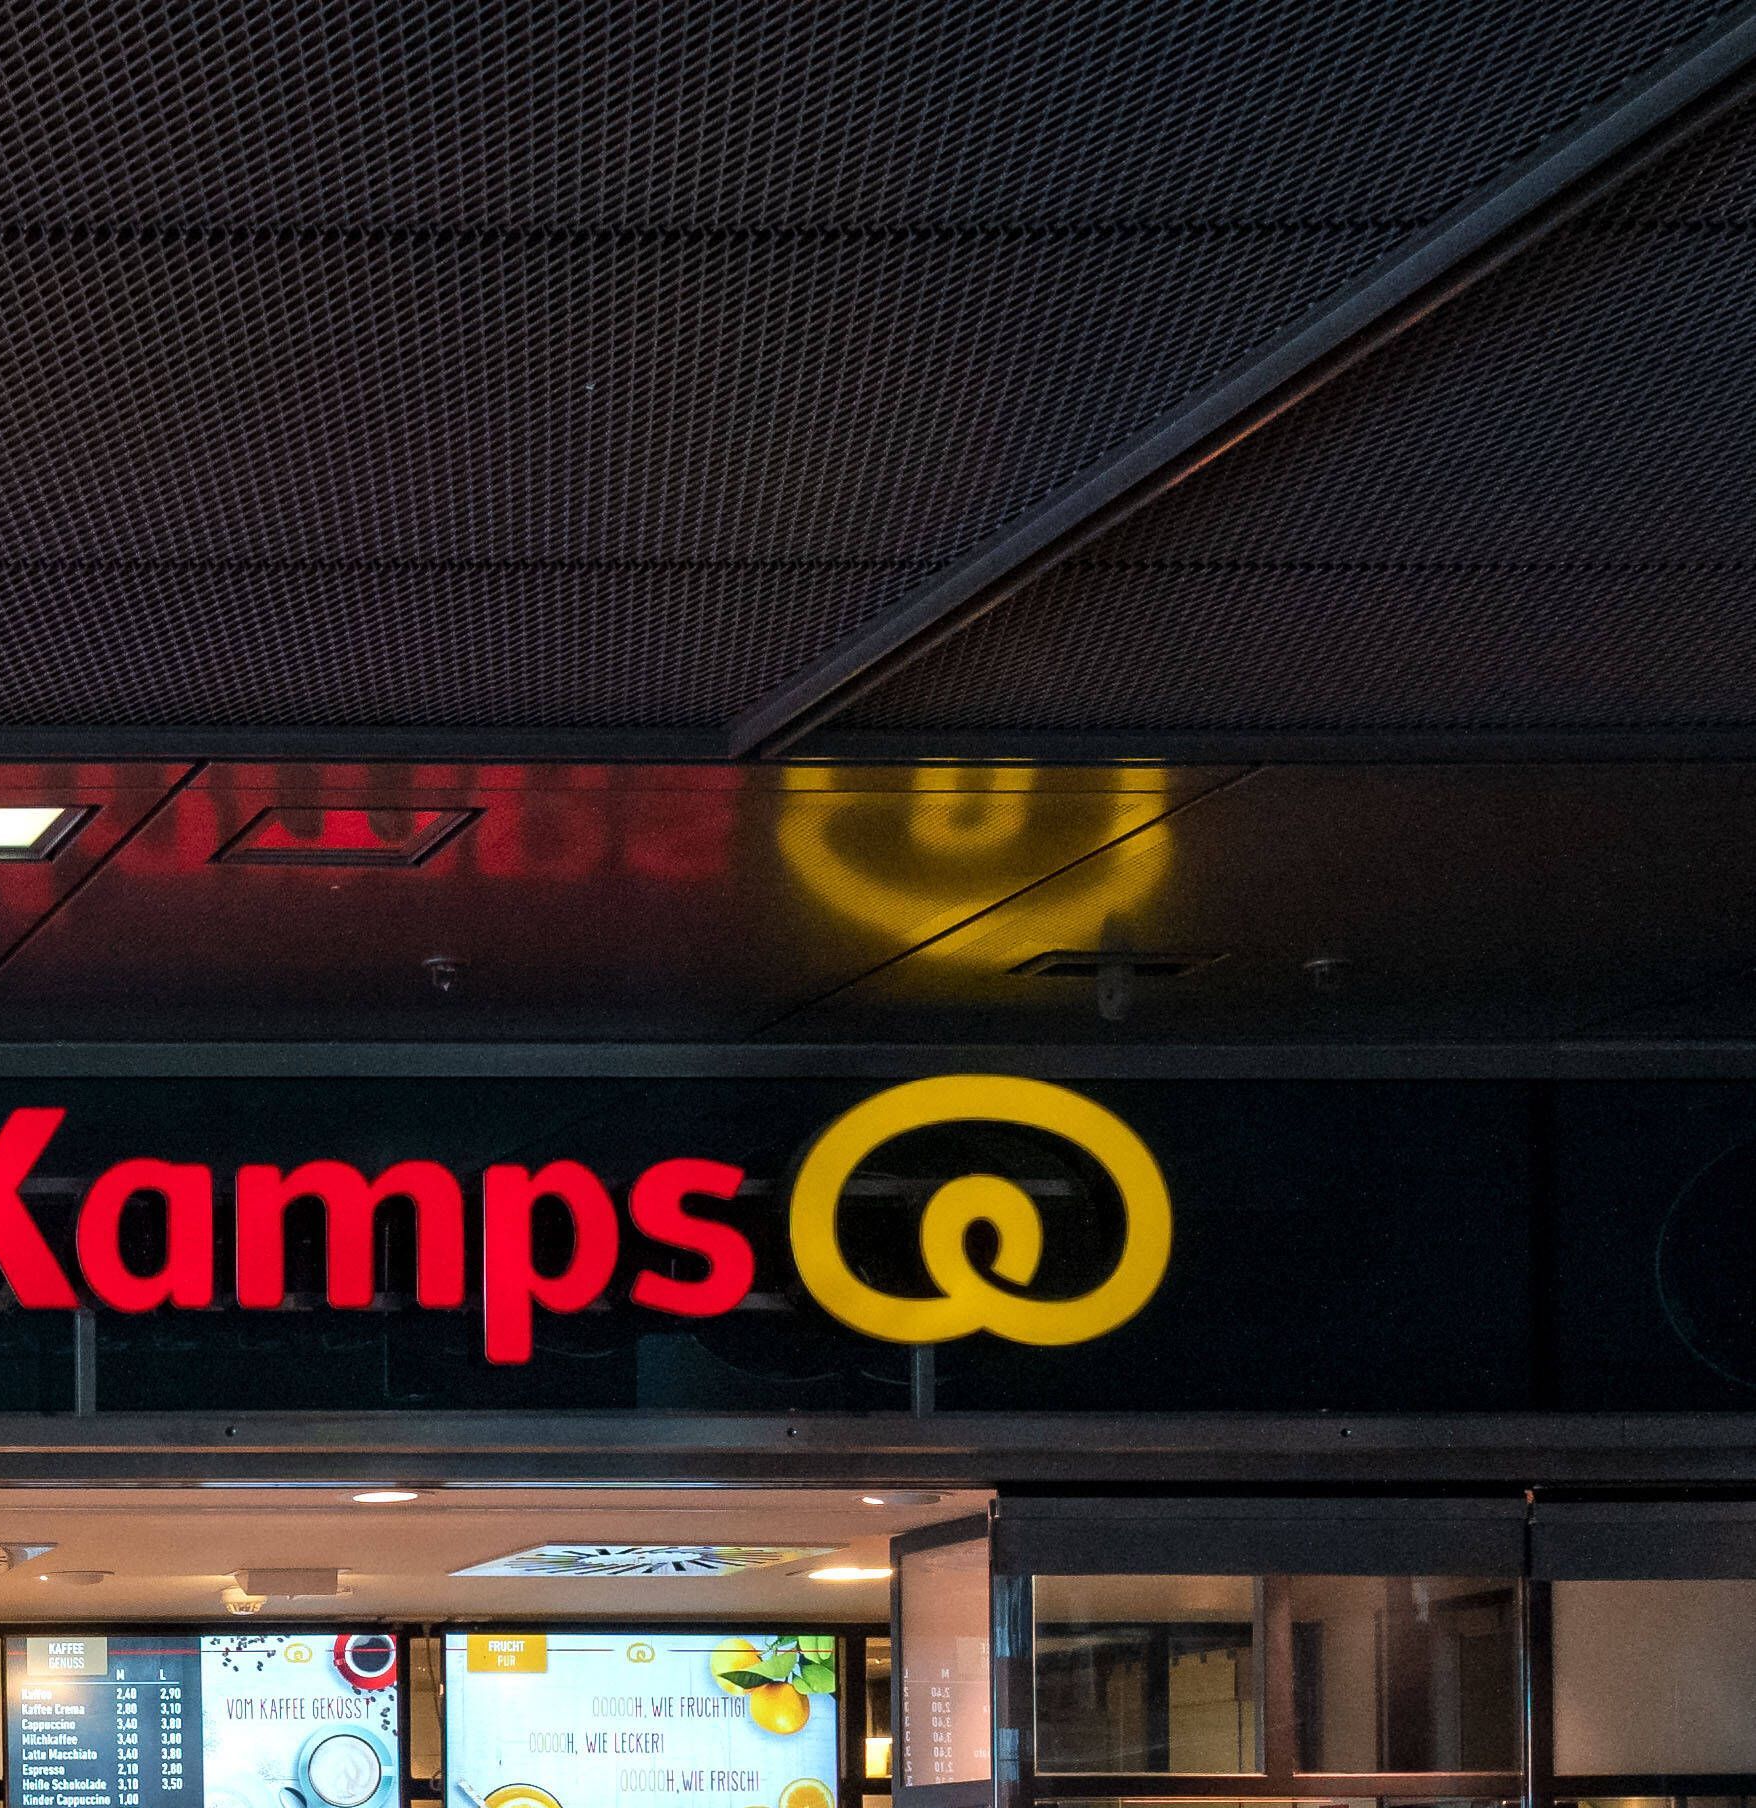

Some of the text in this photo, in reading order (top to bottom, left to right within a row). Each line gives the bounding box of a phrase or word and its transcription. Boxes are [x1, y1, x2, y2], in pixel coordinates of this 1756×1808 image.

[48, 1642, 85, 1655] KAFFEE
[487, 1640, 526, 1653] FRUCHT
[48, 1657, 85, 1669] GENUSS
[159, 1669, 167, 1681] L
[160, 1687, 181, 1701] 2,90
[21, 1703, 85, 1715] Kaffee Crema
[226, 1697, 371, 1720] VOM KAFFEE GEKÜSST
[651, 1697, 674, 1718] WIE
[680, 1697, 746, 1718] FRUCHTIG!
[21, 1718, 76, 1732] Cappuccino
[22, 1733, 79, 1746] Milchkaffee
[586, 1732, 608, 1753] WIE
[614, 1732, 665, 1753] LECKER!
[22, 1749, 98, 1761] Latte Macchiato
[22, 1764, 65, 1777] Espresso
[51, 1778, 107, 1791] Schokolade
[161, 1777, 183, 1790] 3,50
[682, 1770, 705, 1792] WIE
[710, 1770, 760, 1792] FRISCH!
[23, 1793, 111, 1807] Kinder Cappuccino
